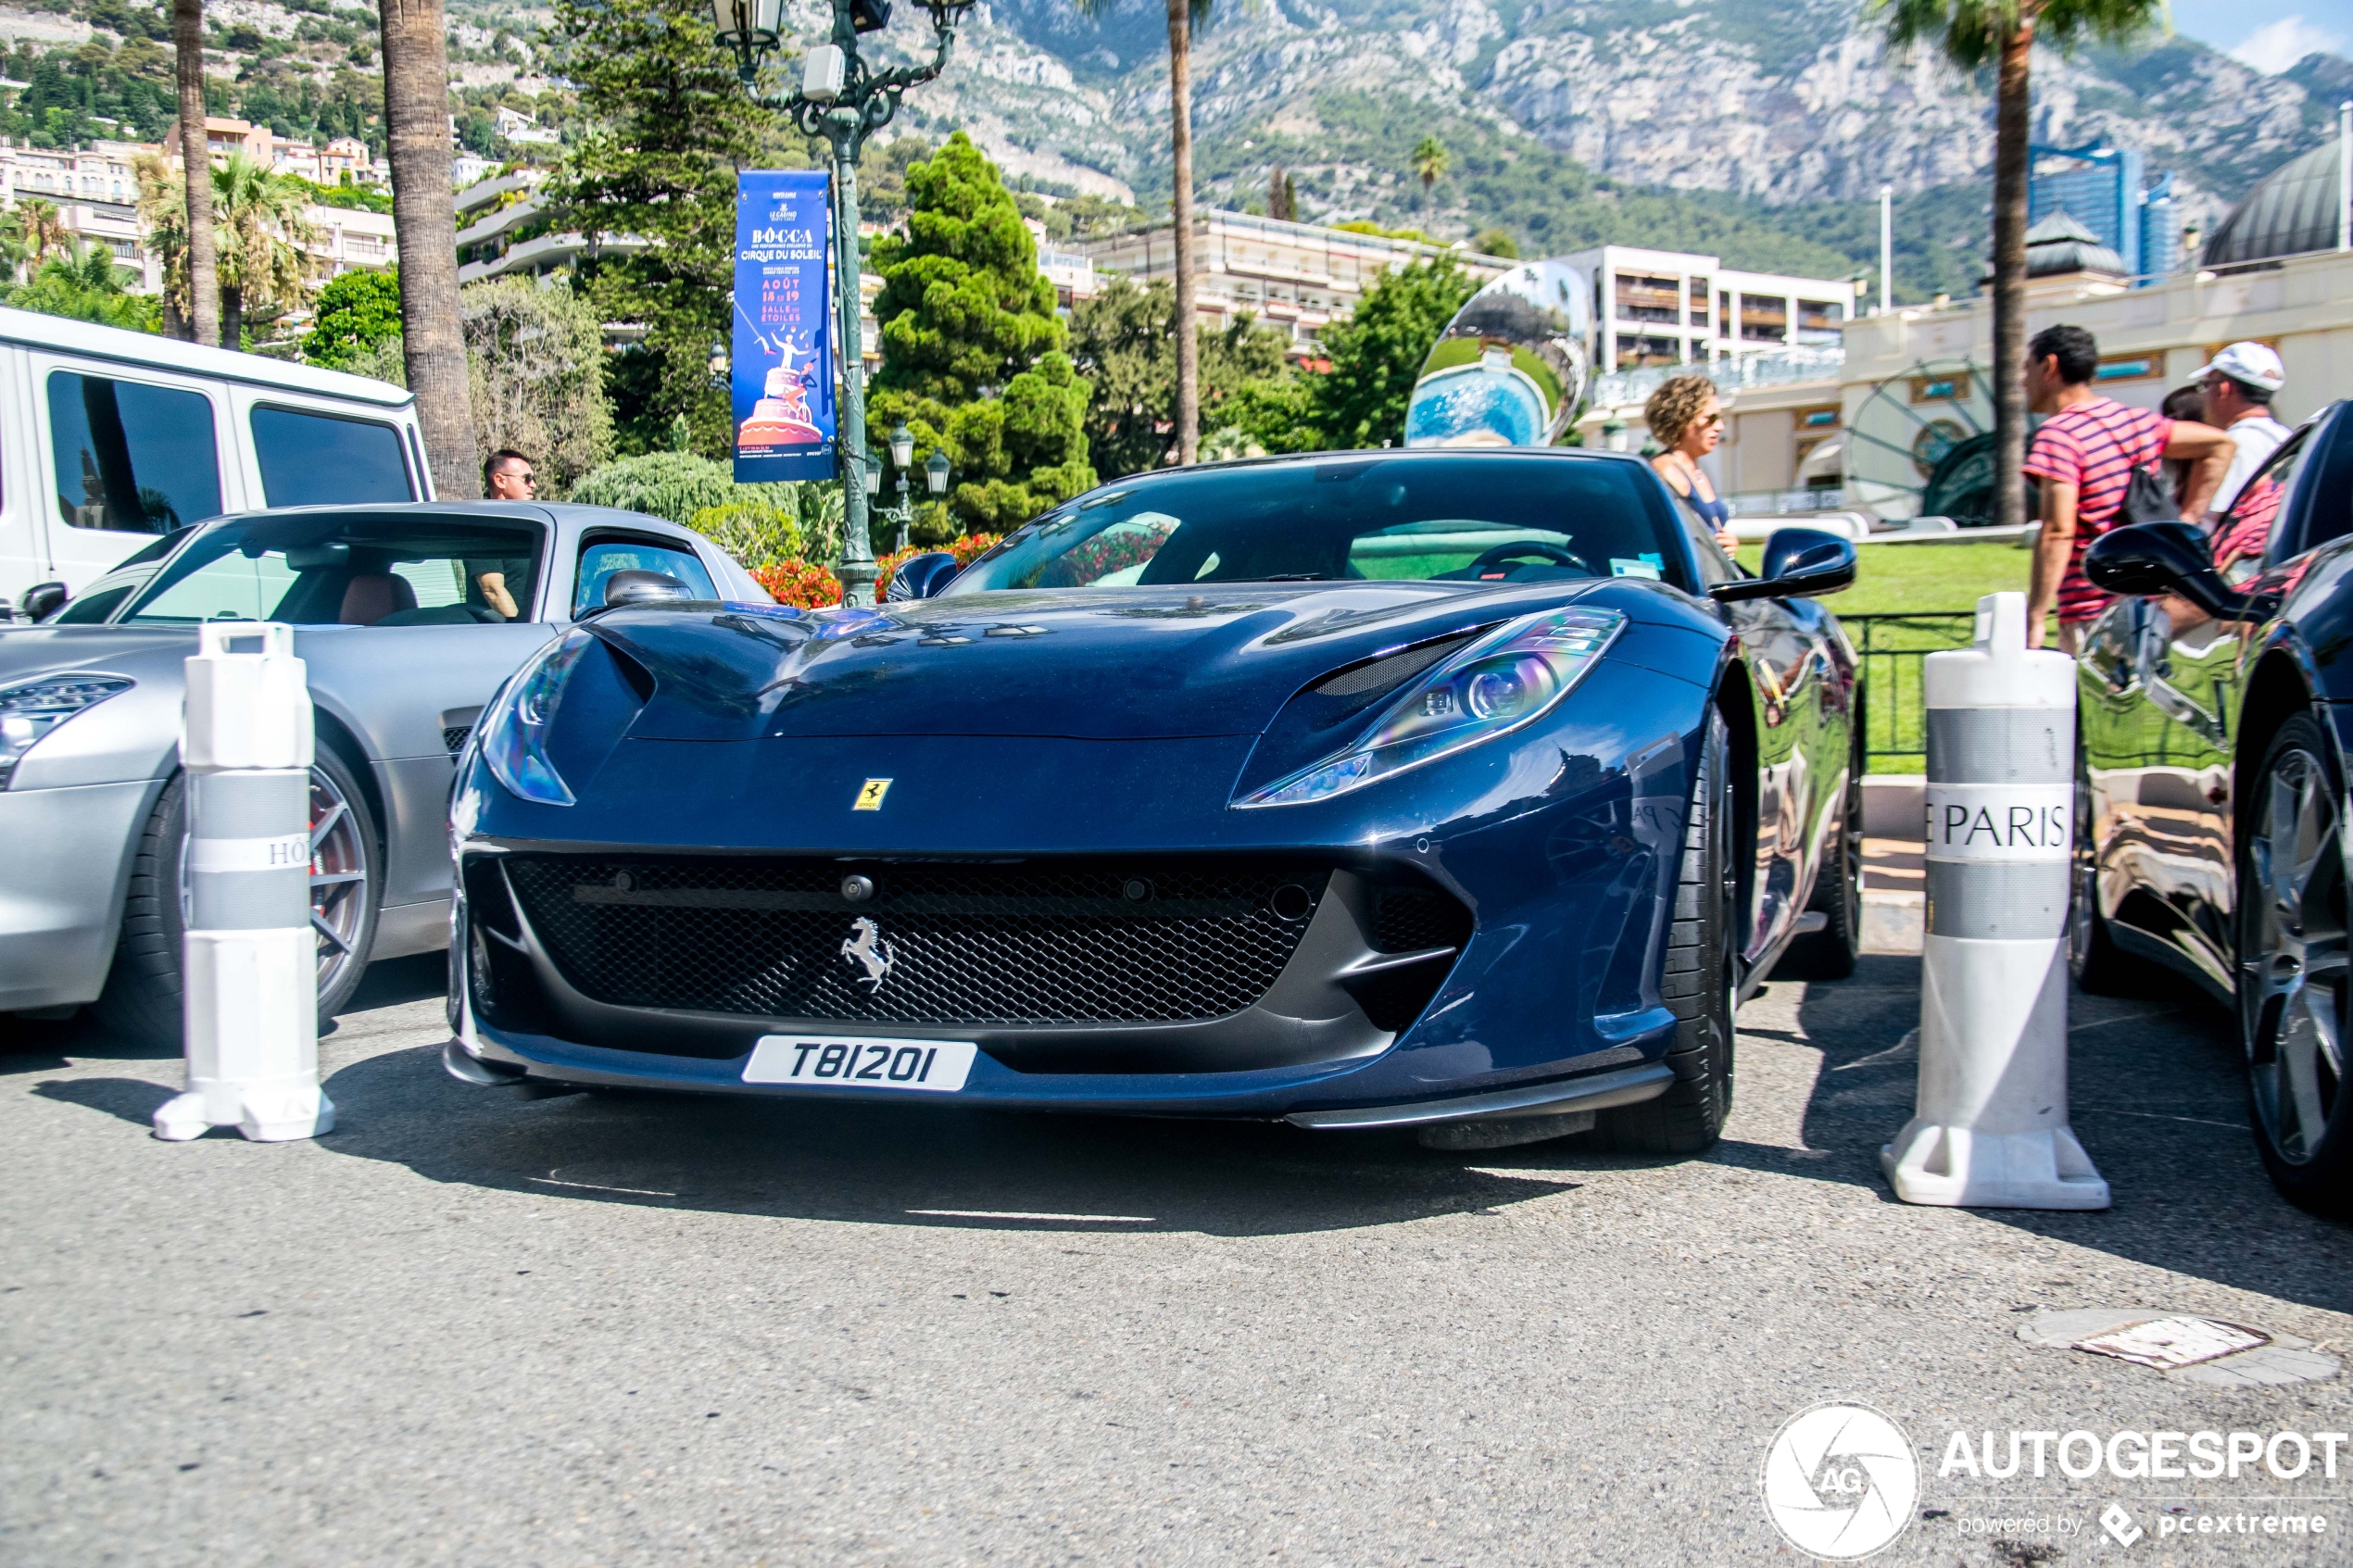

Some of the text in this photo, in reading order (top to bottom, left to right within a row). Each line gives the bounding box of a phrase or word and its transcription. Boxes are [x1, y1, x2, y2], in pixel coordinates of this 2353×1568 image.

[741, 250, 774, 263] CIRQUE
[775, 250, 788, 260] DU
[762, 277, 799, 290] AOÛT
[786, 291, 799, 302] 19
[761, 306, 790, 314] SALLE
[1945, 805, 2065, 847] PARIS
[270, 837, 310, 864] HÔ
[791, 1043, 937, 1082] T81201
